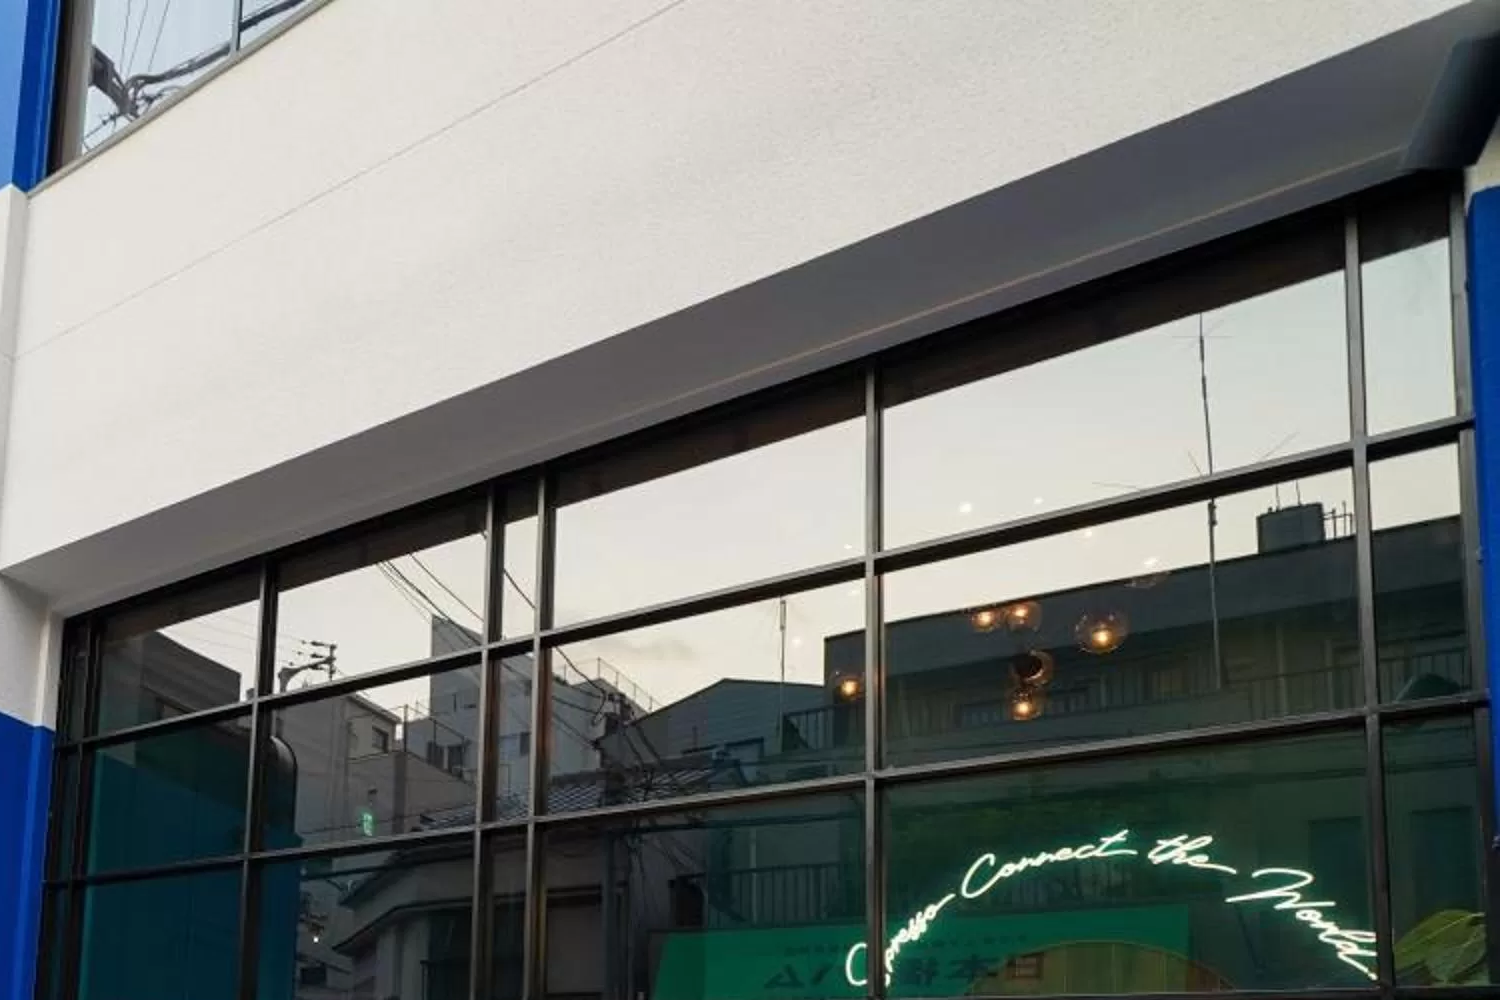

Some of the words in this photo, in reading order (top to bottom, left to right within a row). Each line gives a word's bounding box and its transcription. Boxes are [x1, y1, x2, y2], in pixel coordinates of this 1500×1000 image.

[962, 829, 1138, 899] Connect
[1148, 835, 1237, 874] the
[1225, 868, 1378, 981] World
